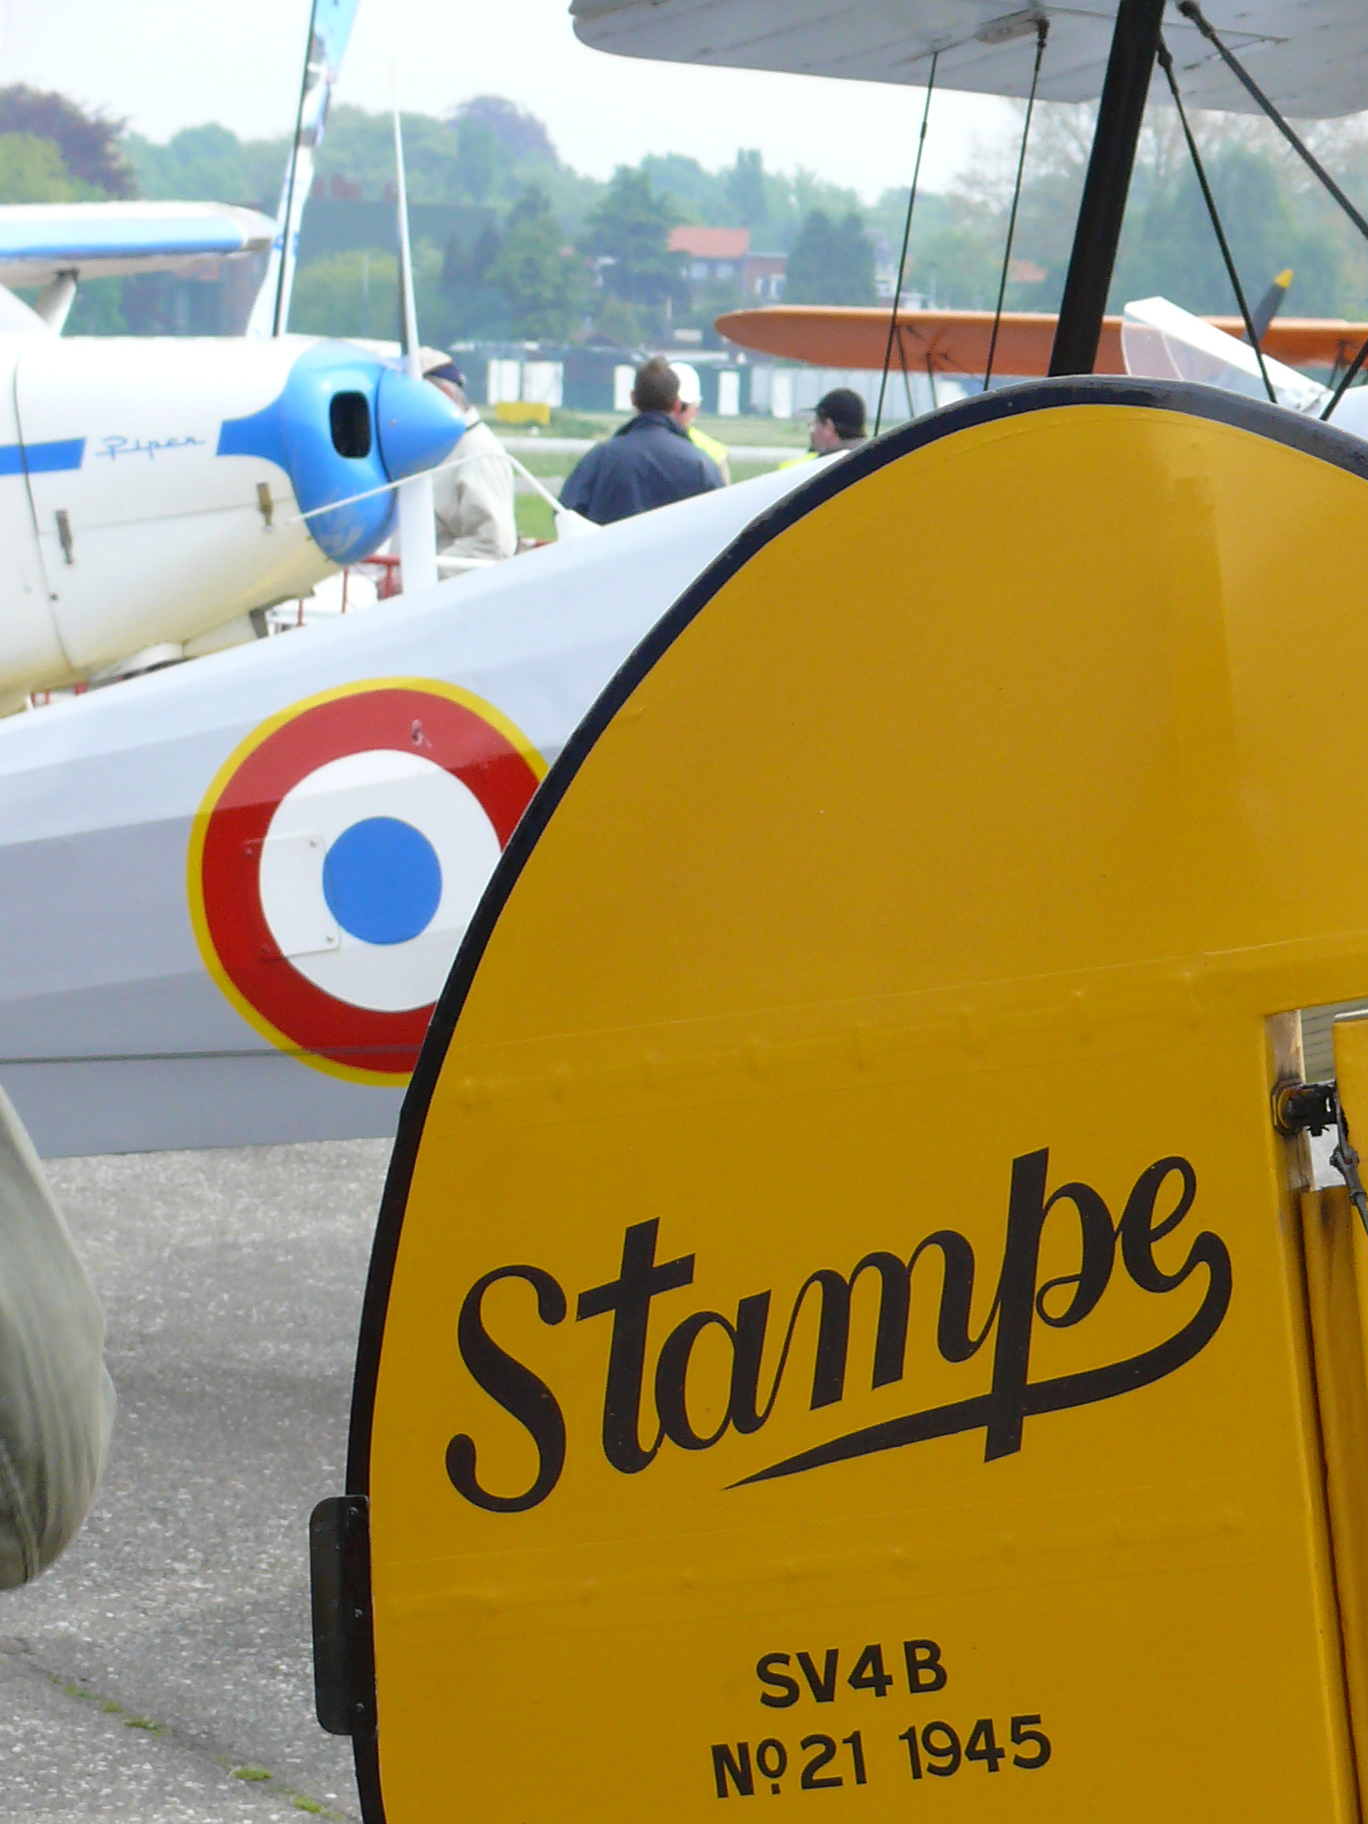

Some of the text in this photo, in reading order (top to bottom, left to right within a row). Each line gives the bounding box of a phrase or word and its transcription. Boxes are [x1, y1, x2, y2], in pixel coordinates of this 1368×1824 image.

[96, 435, 206, 461] Piper
[444, 1146, 1233, 1514] Stampe
[898, 1714, 1052, 1780] 1945
